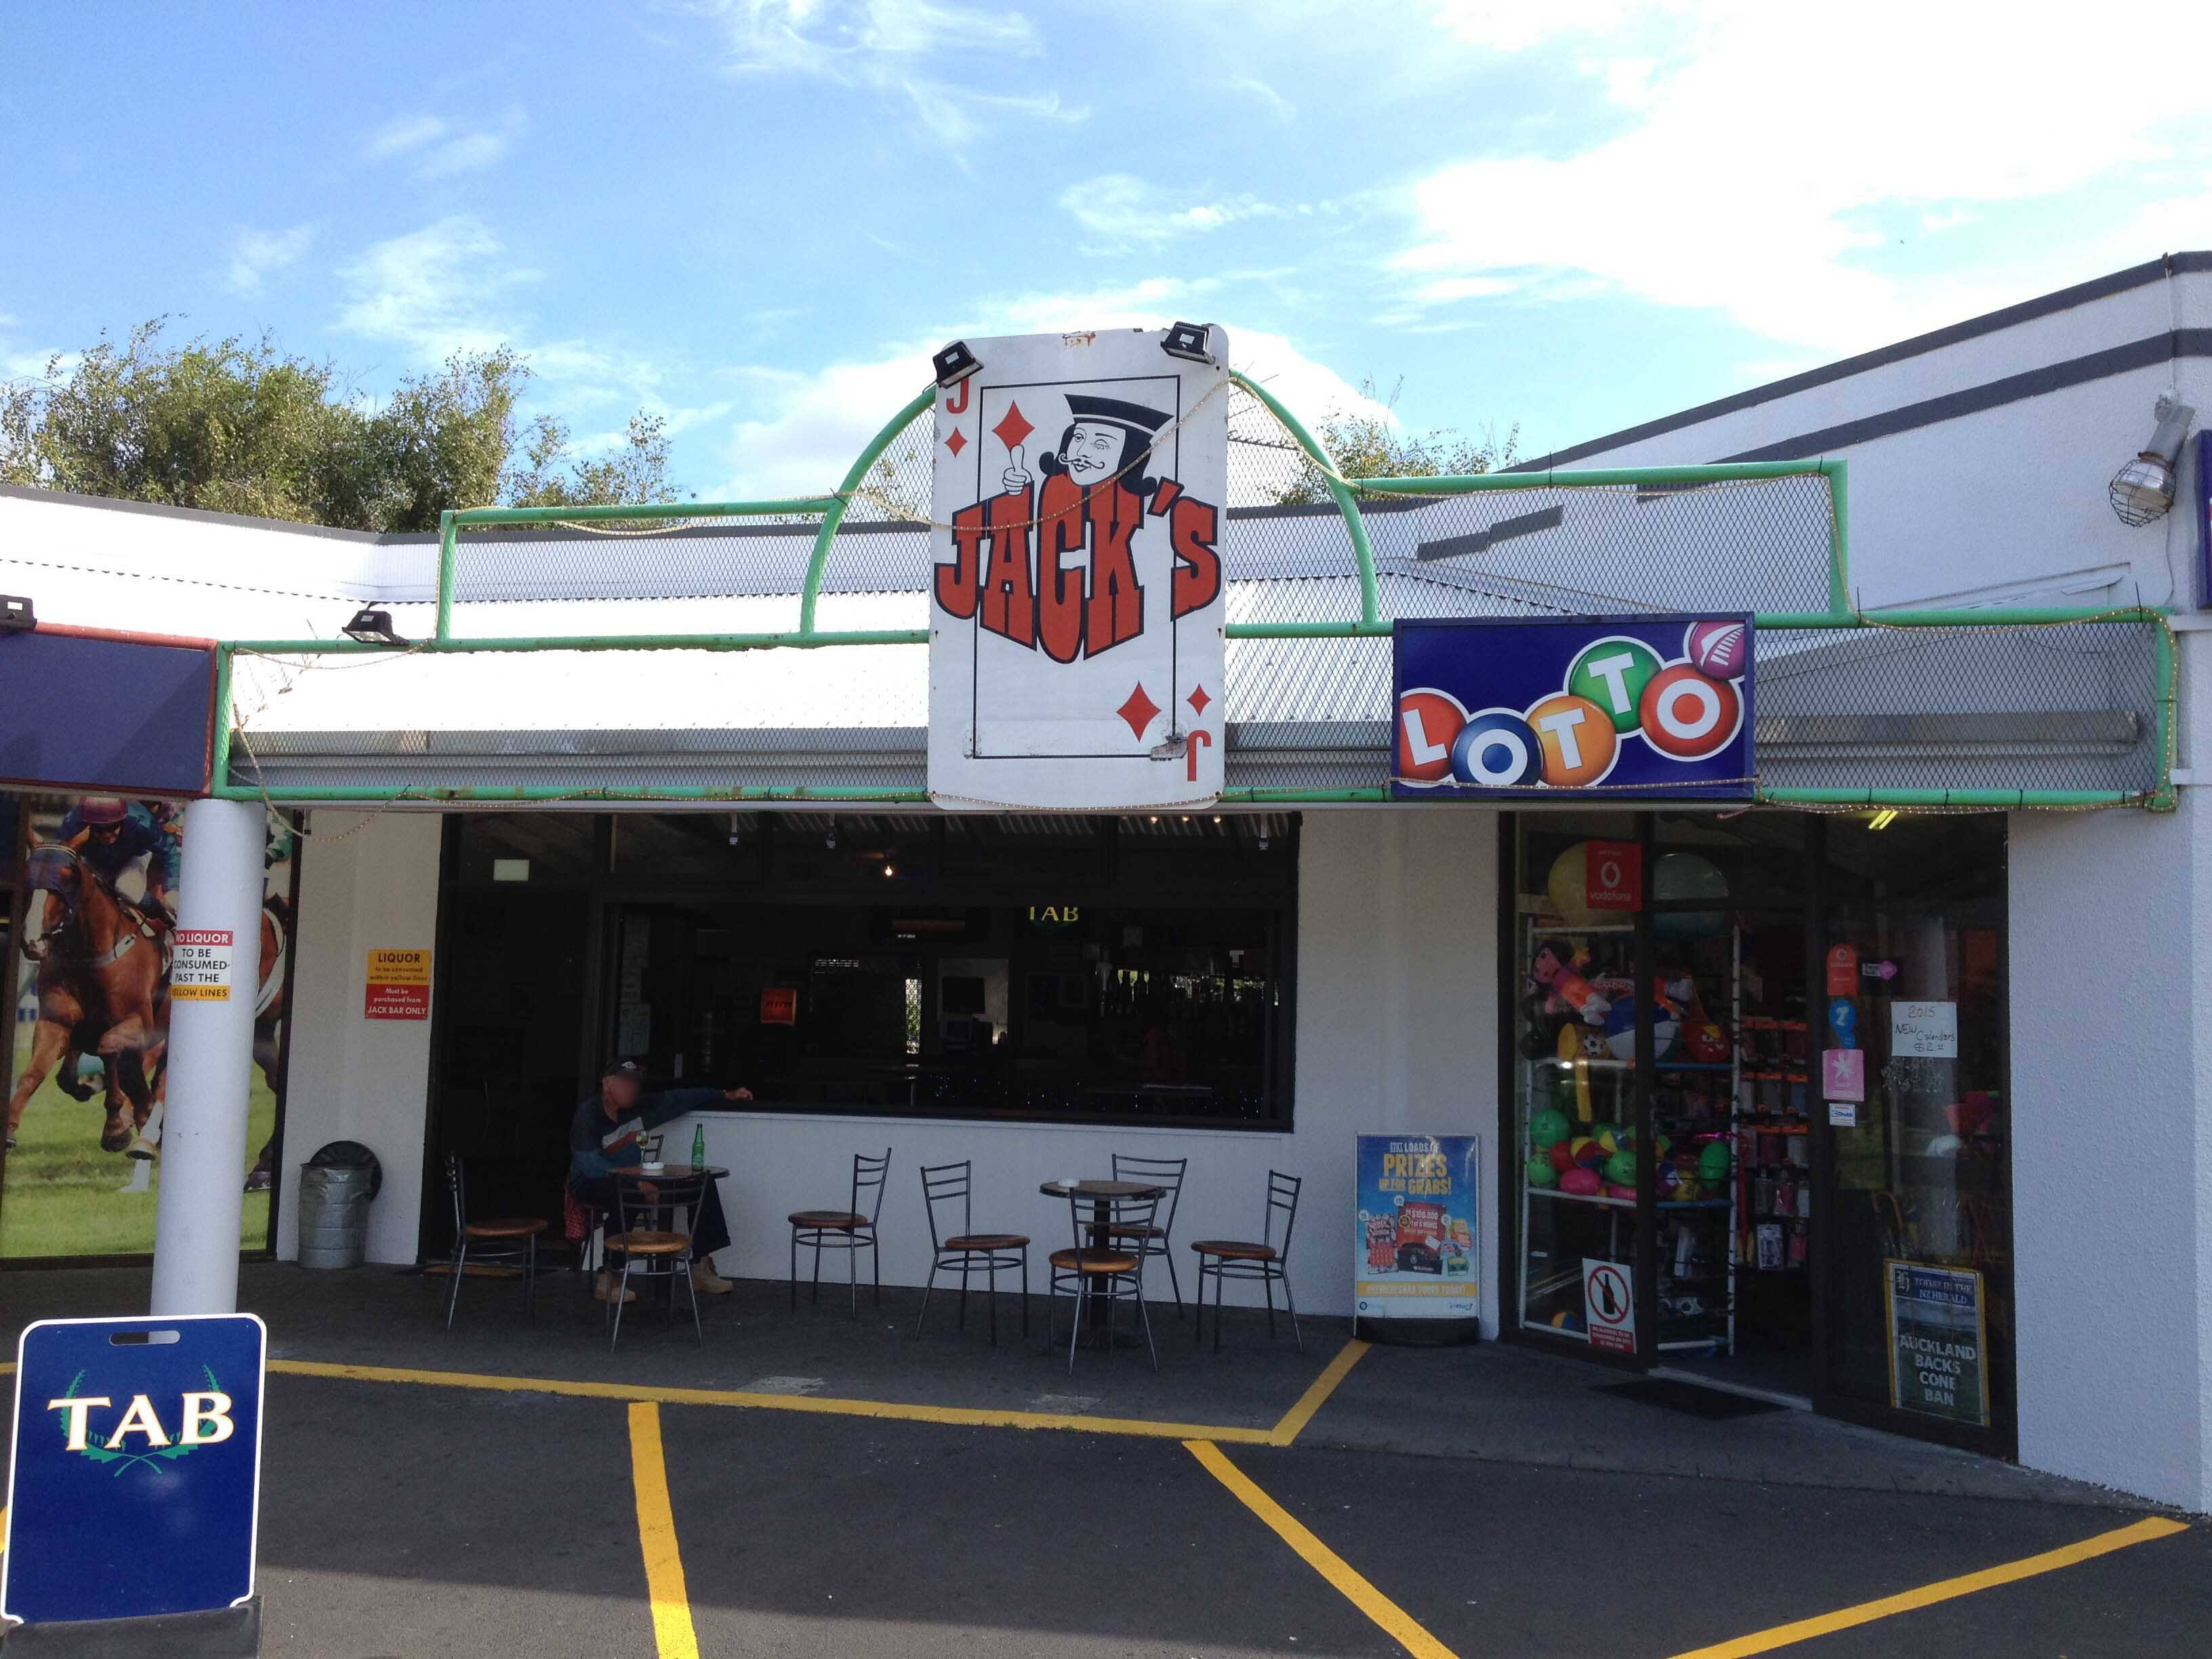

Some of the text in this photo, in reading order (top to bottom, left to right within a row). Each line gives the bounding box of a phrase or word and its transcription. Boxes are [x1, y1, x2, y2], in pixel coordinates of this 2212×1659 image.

[935, 472, 1222, 663] JACK'S
[1402, 652, 1721, 786] LOTTO
[186, 933, 228, 943] LIQUOR
[182, 949, 211, 958] TO BE
[378, 953, 420, 963] LIQUOR
[173, 960, 227, 970] CONSUMED
[175, 973, 219, 983] PAST THE
[200, 989, 227, 997] LINES
[1908, 1005, 1936, 1018] 2015
[1895, 1023, 1917, 1034] NEW
[1404, 1142, 1429, 1153] LOADS
[1384, 1153, 1448, 1177] PRIZES
[1408, 1177, 1452, 1195] GRABS!
[1919, 1289, 1967, 1304] NZ HERALD
[1898, 1334, 1976, 1360] AUCKLAND
[1914, 1353, 1961, 1374] BACKS
[1919, 1371, 1957, 1390] CONE
[1925, 1387, 1954, 1406] BAN
[47, 1391, 234, 1451] TAB
